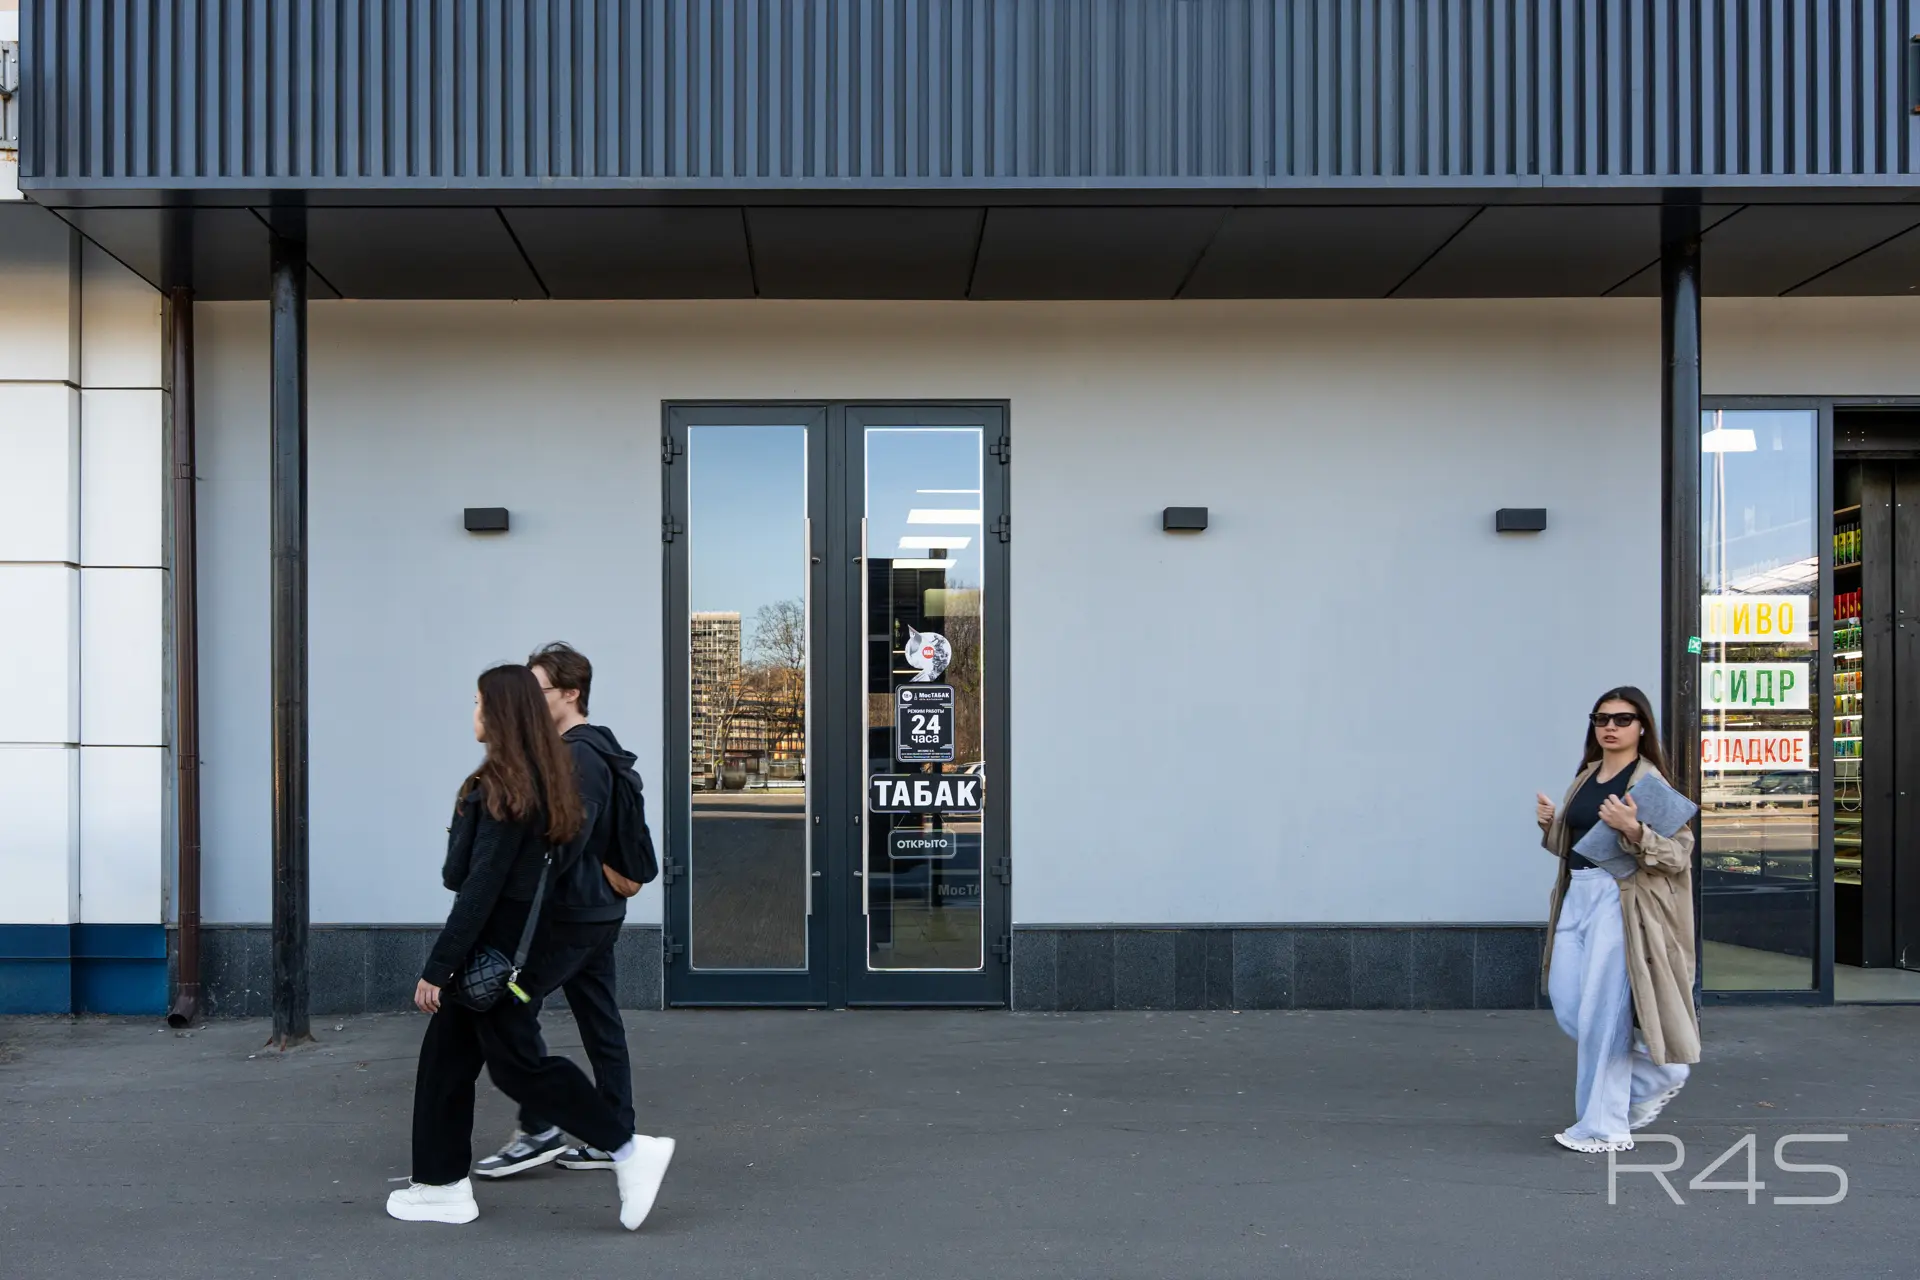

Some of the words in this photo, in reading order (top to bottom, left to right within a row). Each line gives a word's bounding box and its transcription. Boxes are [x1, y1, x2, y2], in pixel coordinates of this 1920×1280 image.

[1709, 602, 1795, 635] ПИВО
[1709, 669, 1795, 707] СИДР
[911, 714, 941, 734] 24
[911, 735, 940, 743] часа
[1701, 738, 1804, 765] СЛАДКОЕ
[873, 780, 977, 806] ТАБАК
[897, 839, 948, 849] ОТКРЫТО
